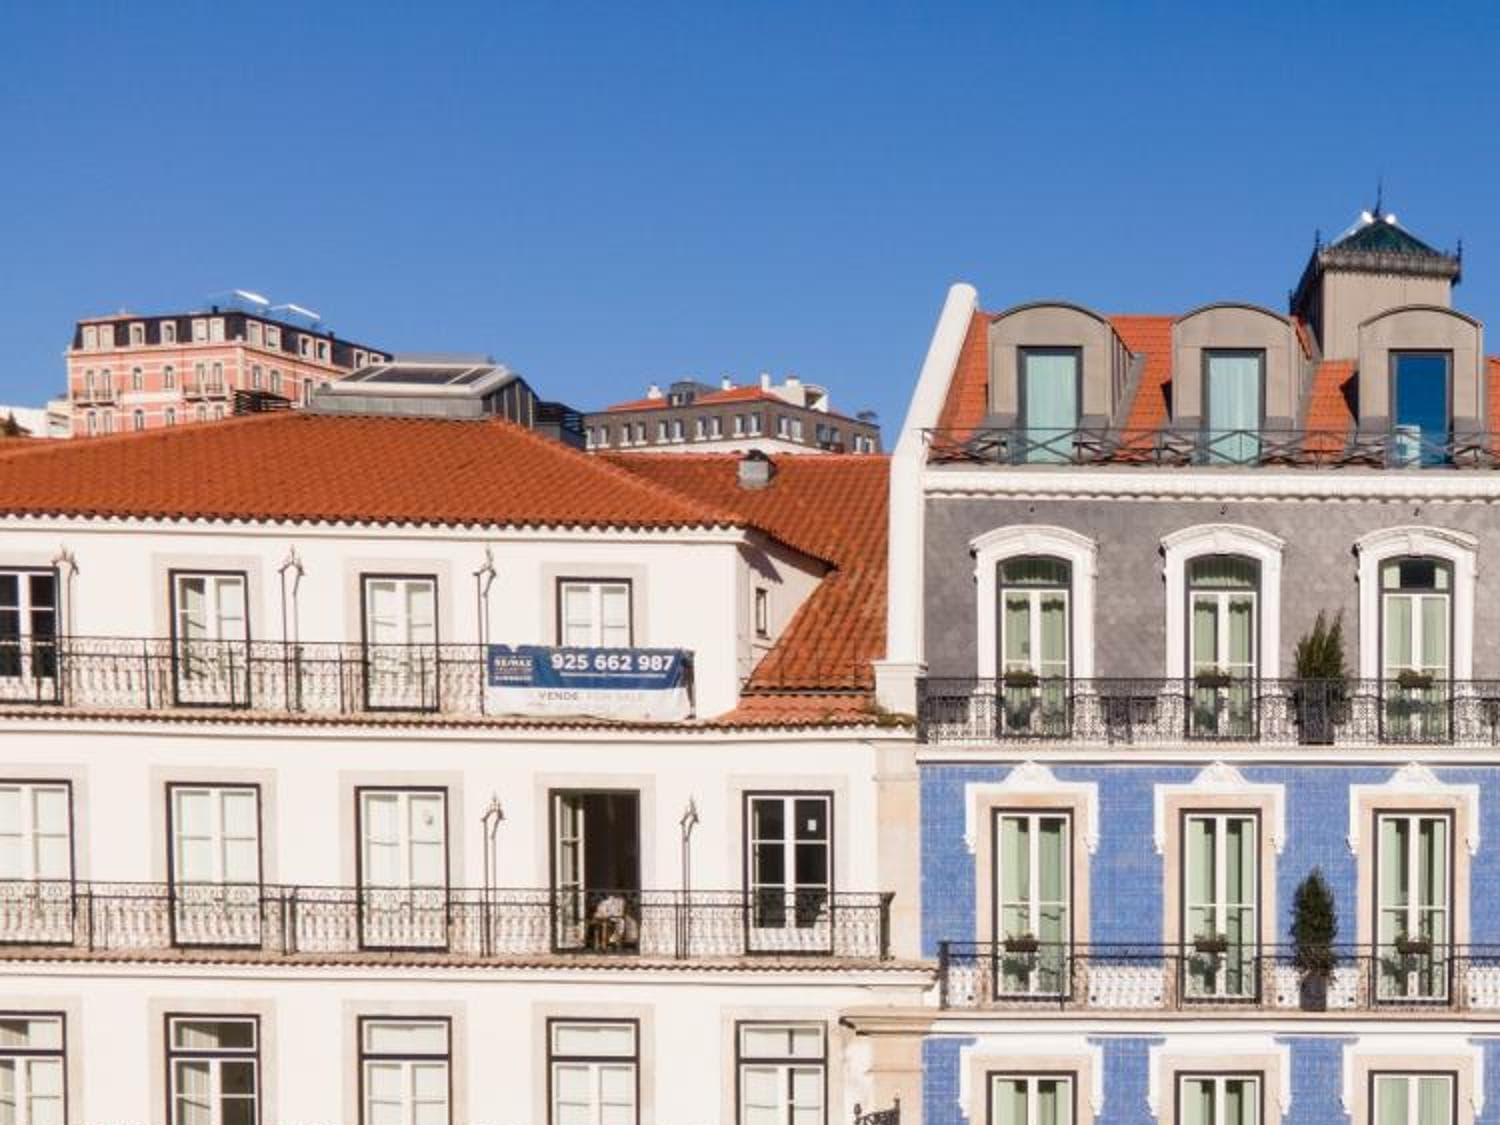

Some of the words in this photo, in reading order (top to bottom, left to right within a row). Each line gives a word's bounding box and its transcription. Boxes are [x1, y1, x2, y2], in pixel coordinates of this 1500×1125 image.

[552, 653, 589, 669] 925
[594, 655, 632, 670] 662
[638, 656, 674, 671] 987
